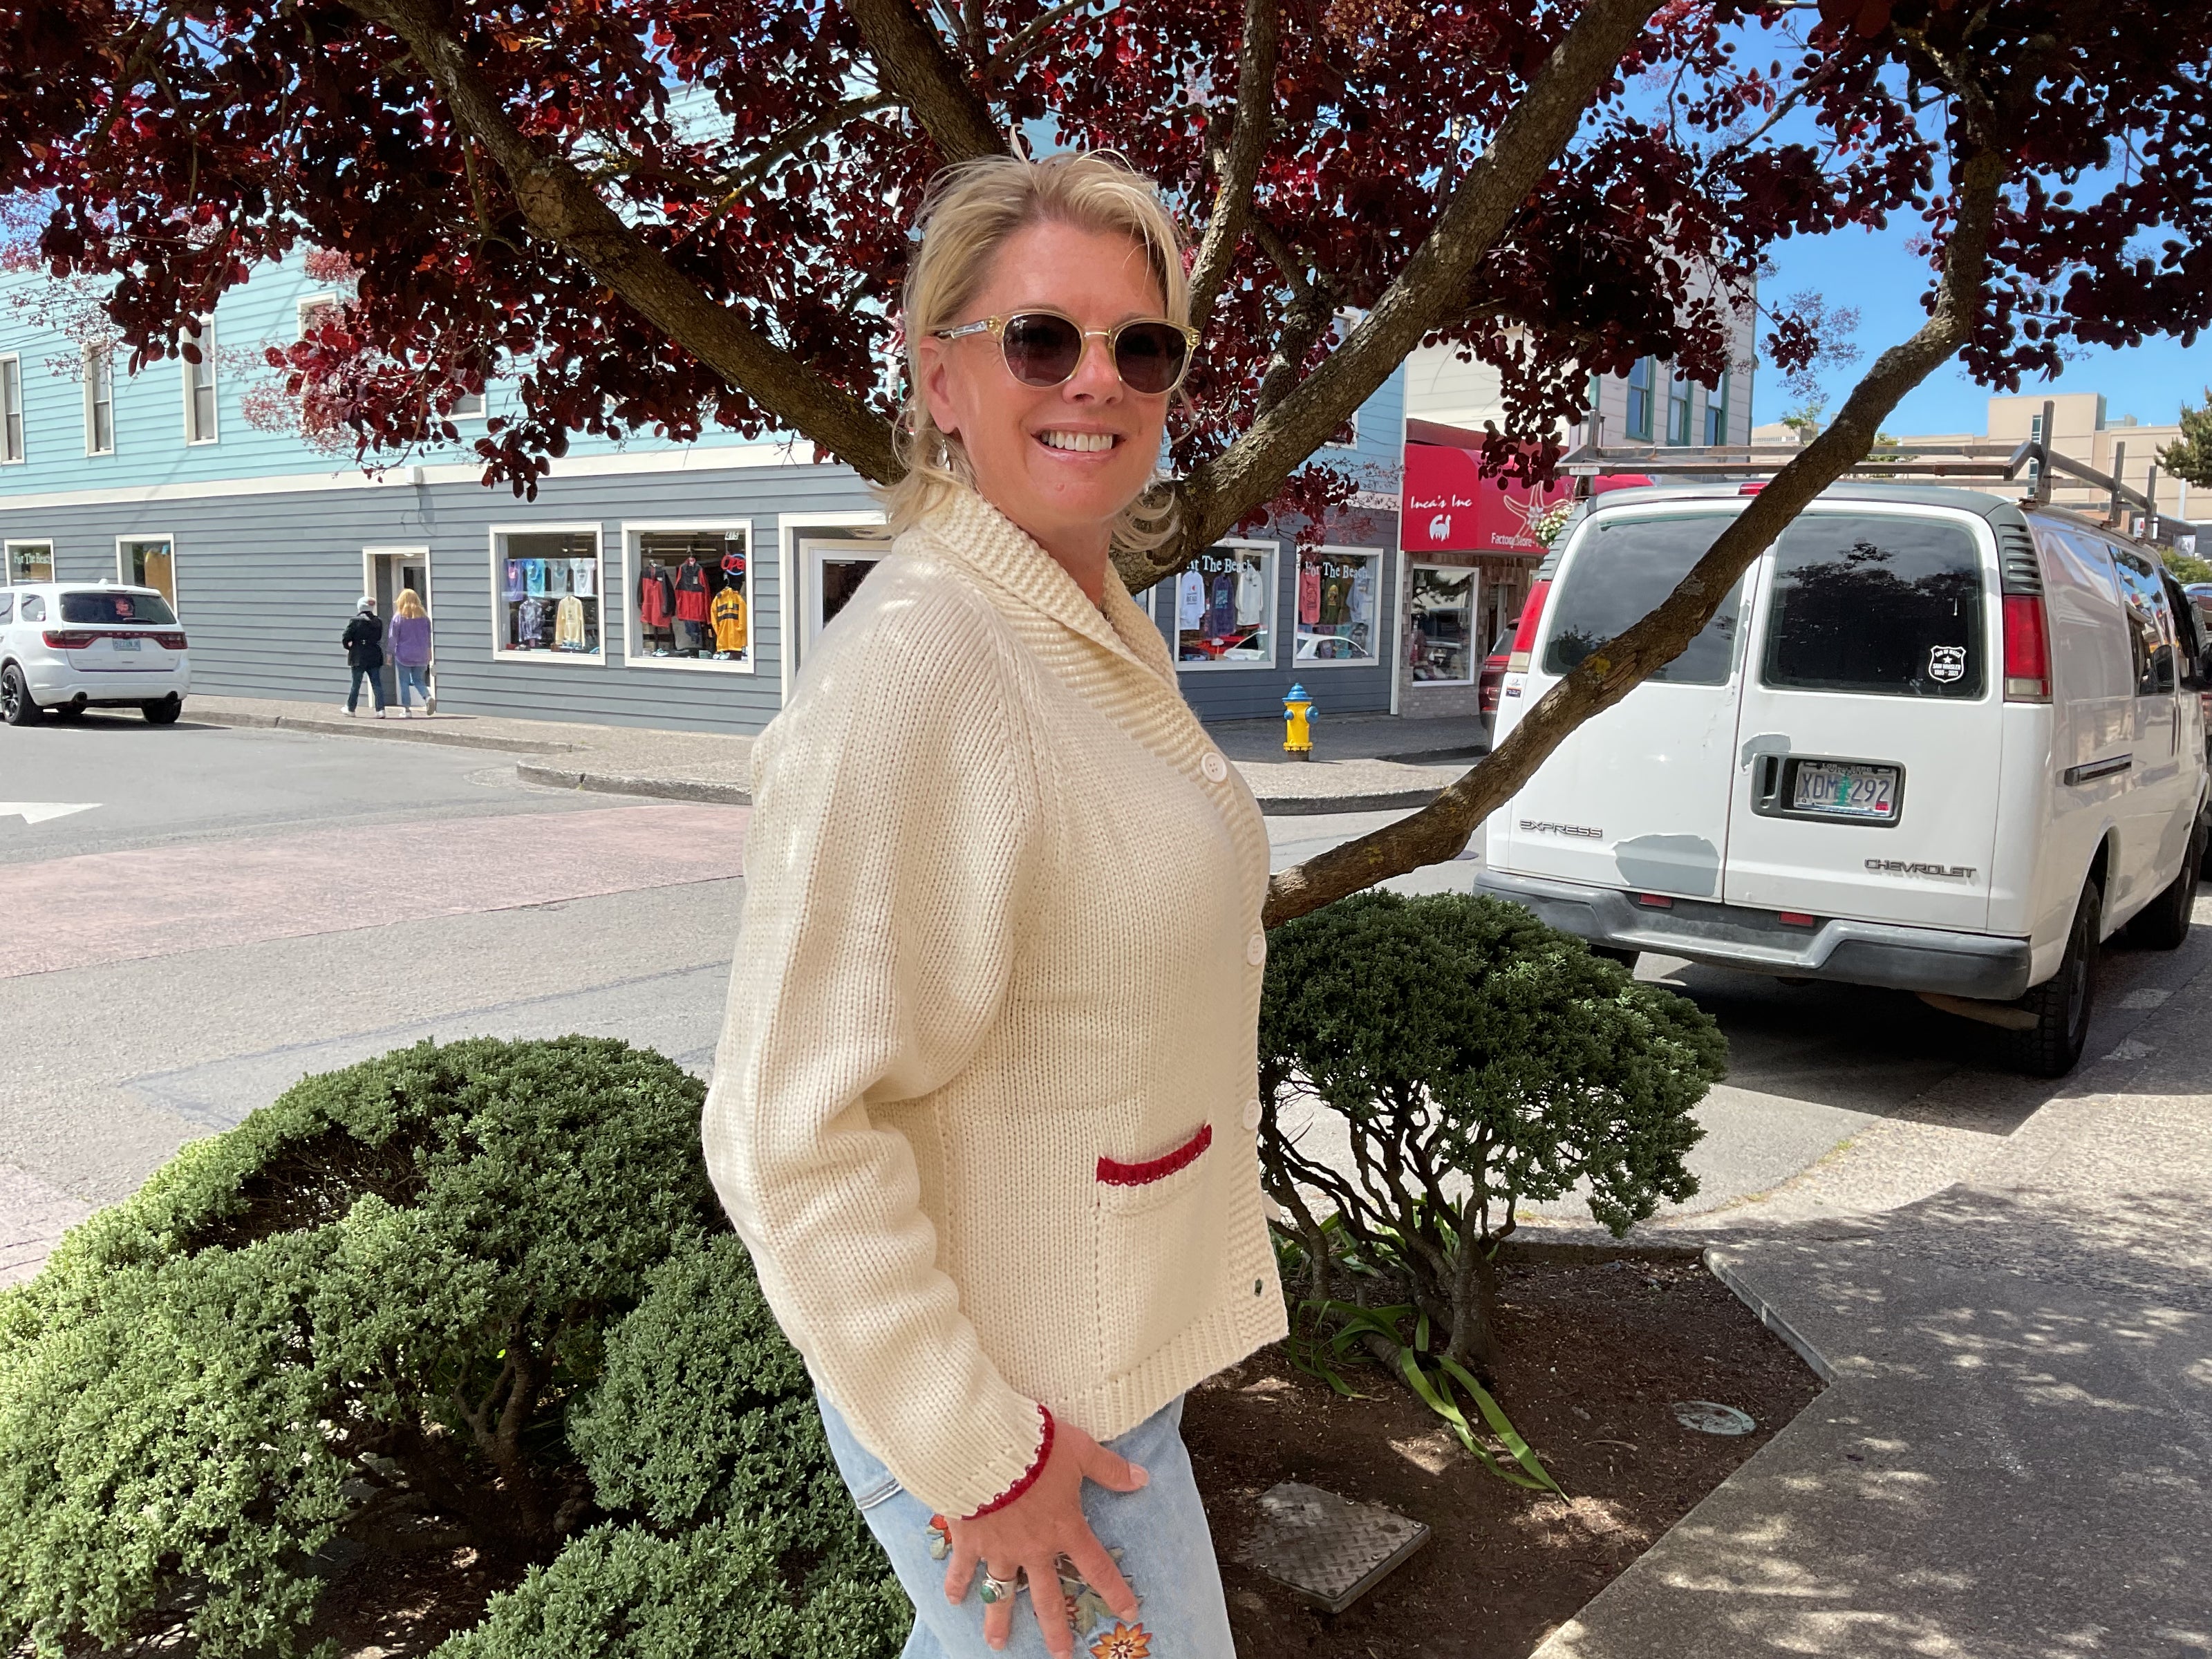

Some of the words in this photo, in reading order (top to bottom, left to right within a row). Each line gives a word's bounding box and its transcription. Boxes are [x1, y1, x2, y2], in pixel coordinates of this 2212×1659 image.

[1411, 495, 1446, 509] Inca's
[1452, 494, 1472, 507] Inc
[726, 531, 738, 539] 415
[24, 552, 35, 564] The
[721, 554, 745, 571] Ope
[1202, 555, 1222, 572] The
[1323, 562, 1340, 578] The
[1801, 774, 1839, 799] XDM
[1850, 778, 1890, 803] 292
[1519, 819, 1603, 838] EXPRESS
[1864, 859, 1976, 877] CHEVROLET
